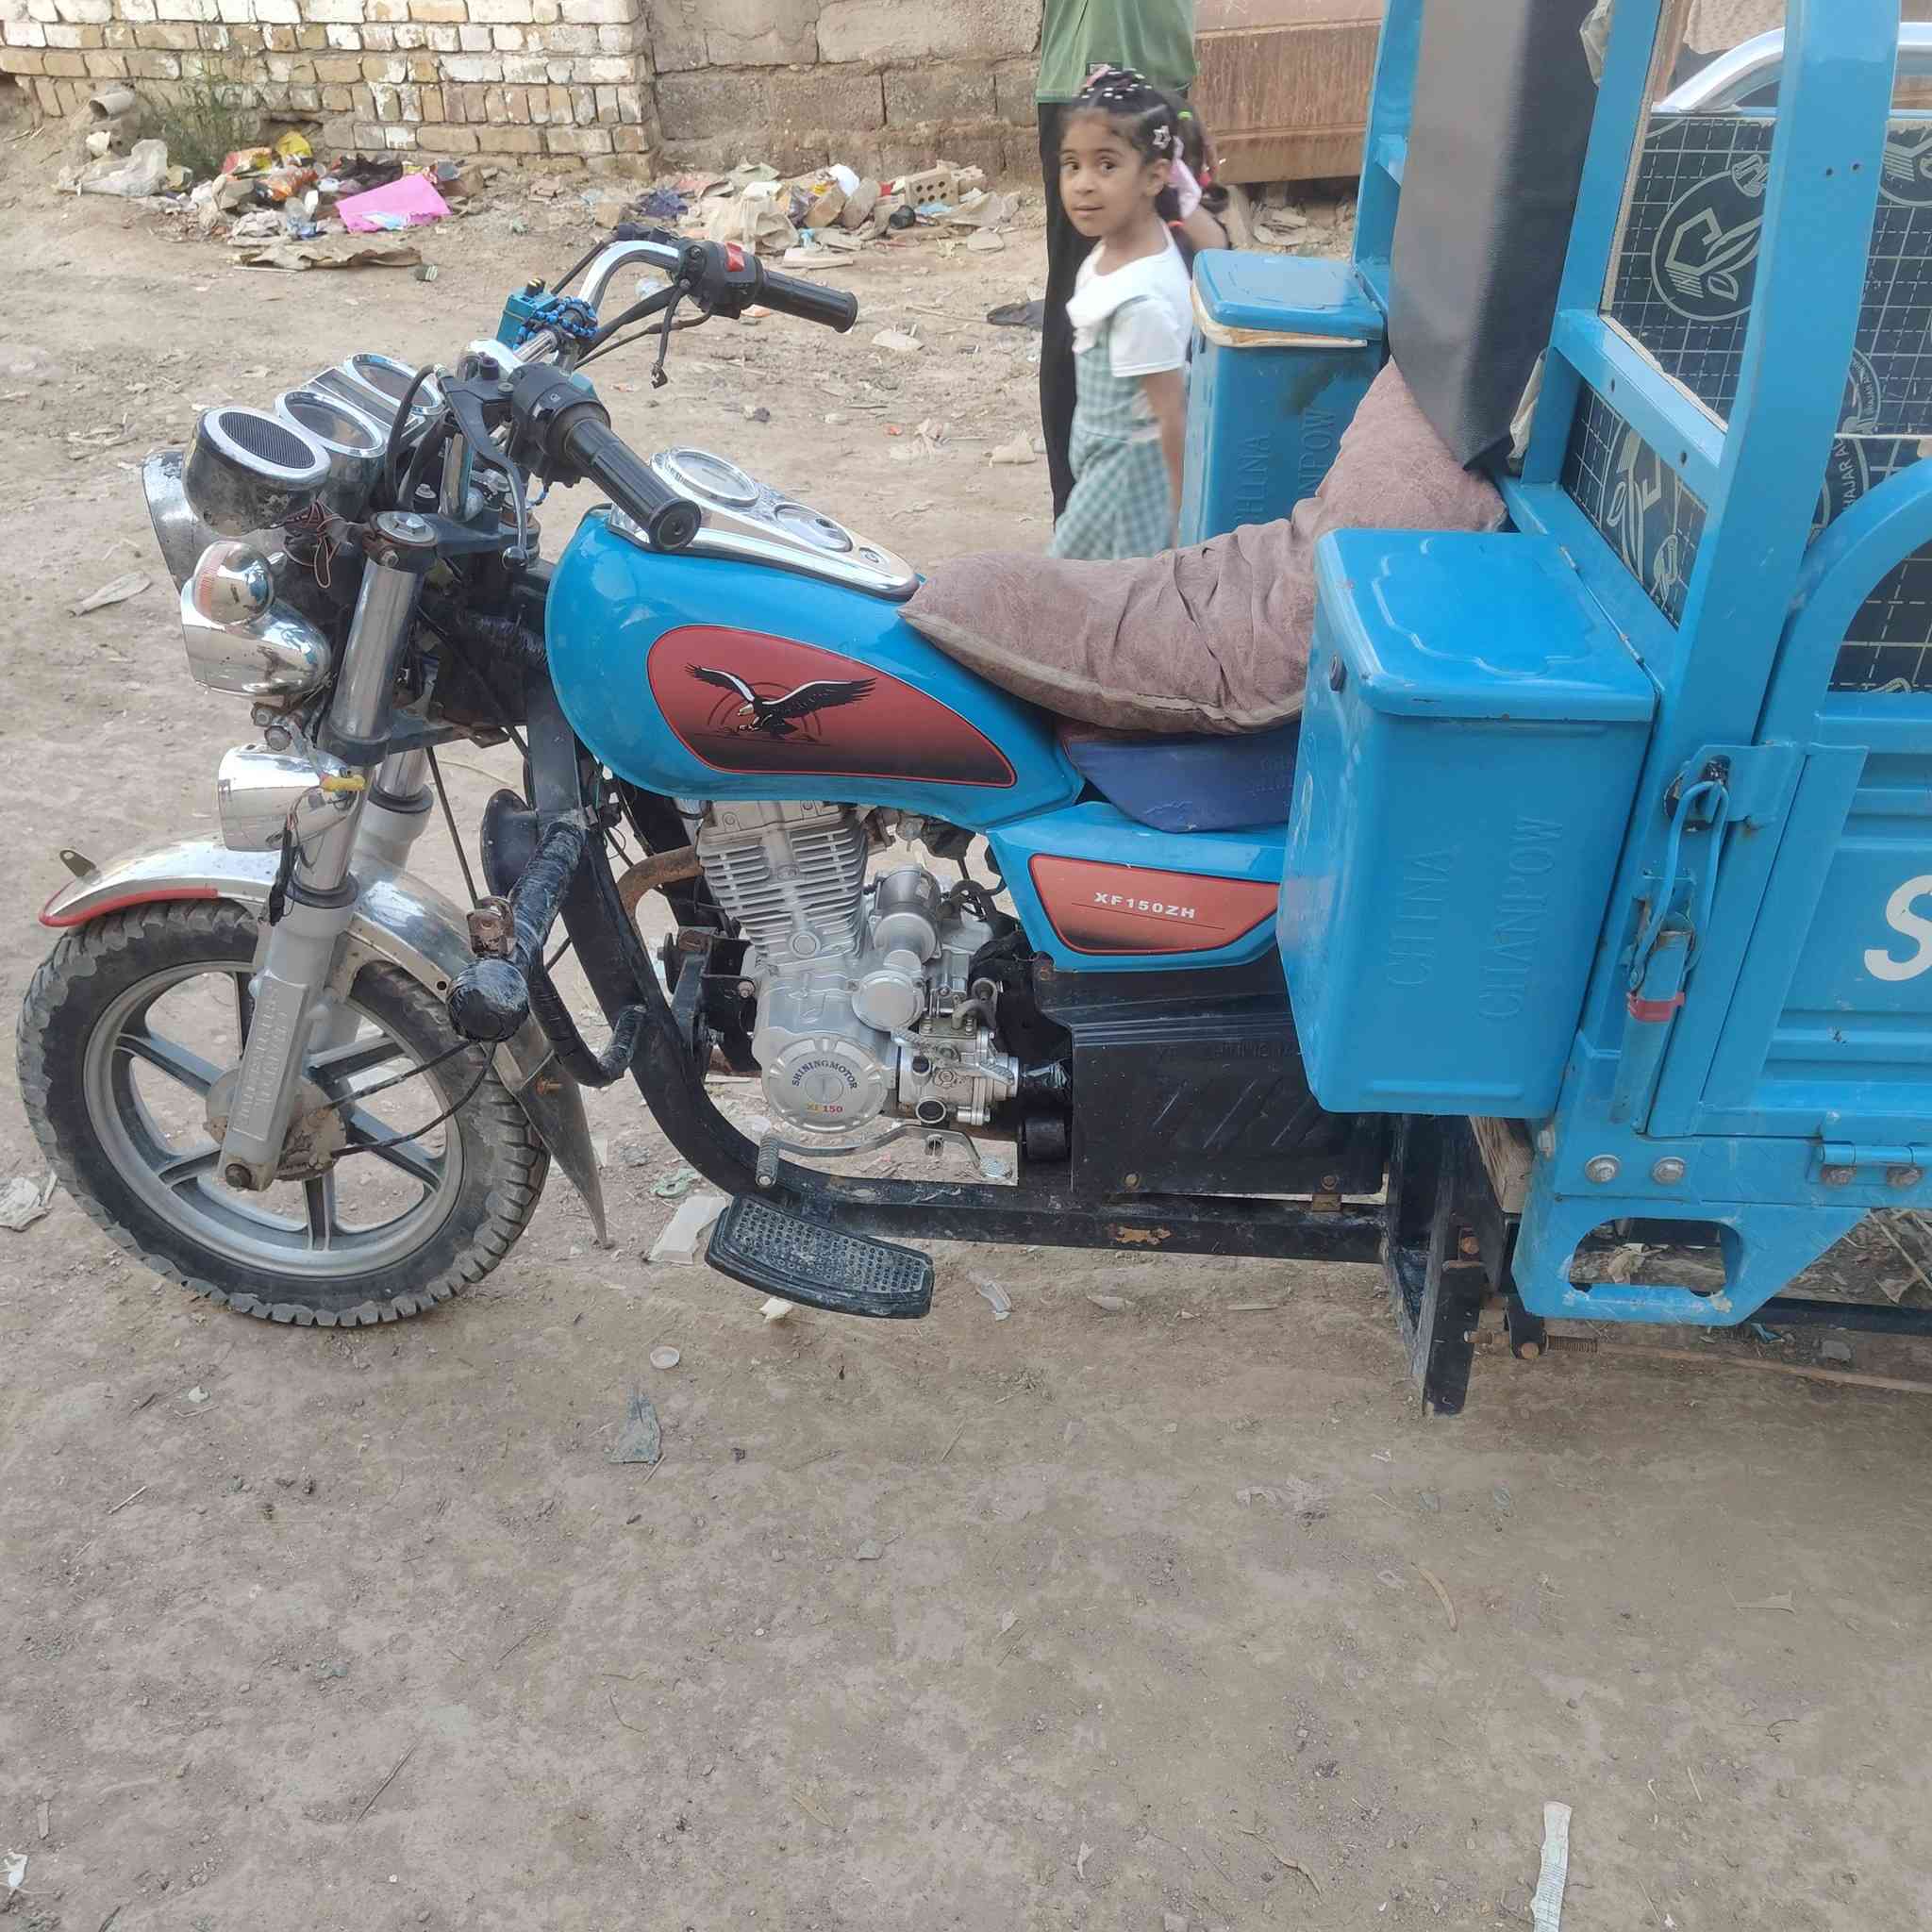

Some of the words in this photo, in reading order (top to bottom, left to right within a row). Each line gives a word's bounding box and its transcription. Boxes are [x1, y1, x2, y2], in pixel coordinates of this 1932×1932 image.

[1235, 434, 1270, 522] HINA
[1093, 891, 1196, 919] XF150ZH
[1387, 848, 1454, 988] CHINA
[1478, 814, 1563, 1020] CHANPOW
[1864, 874, 1932, 981] S
